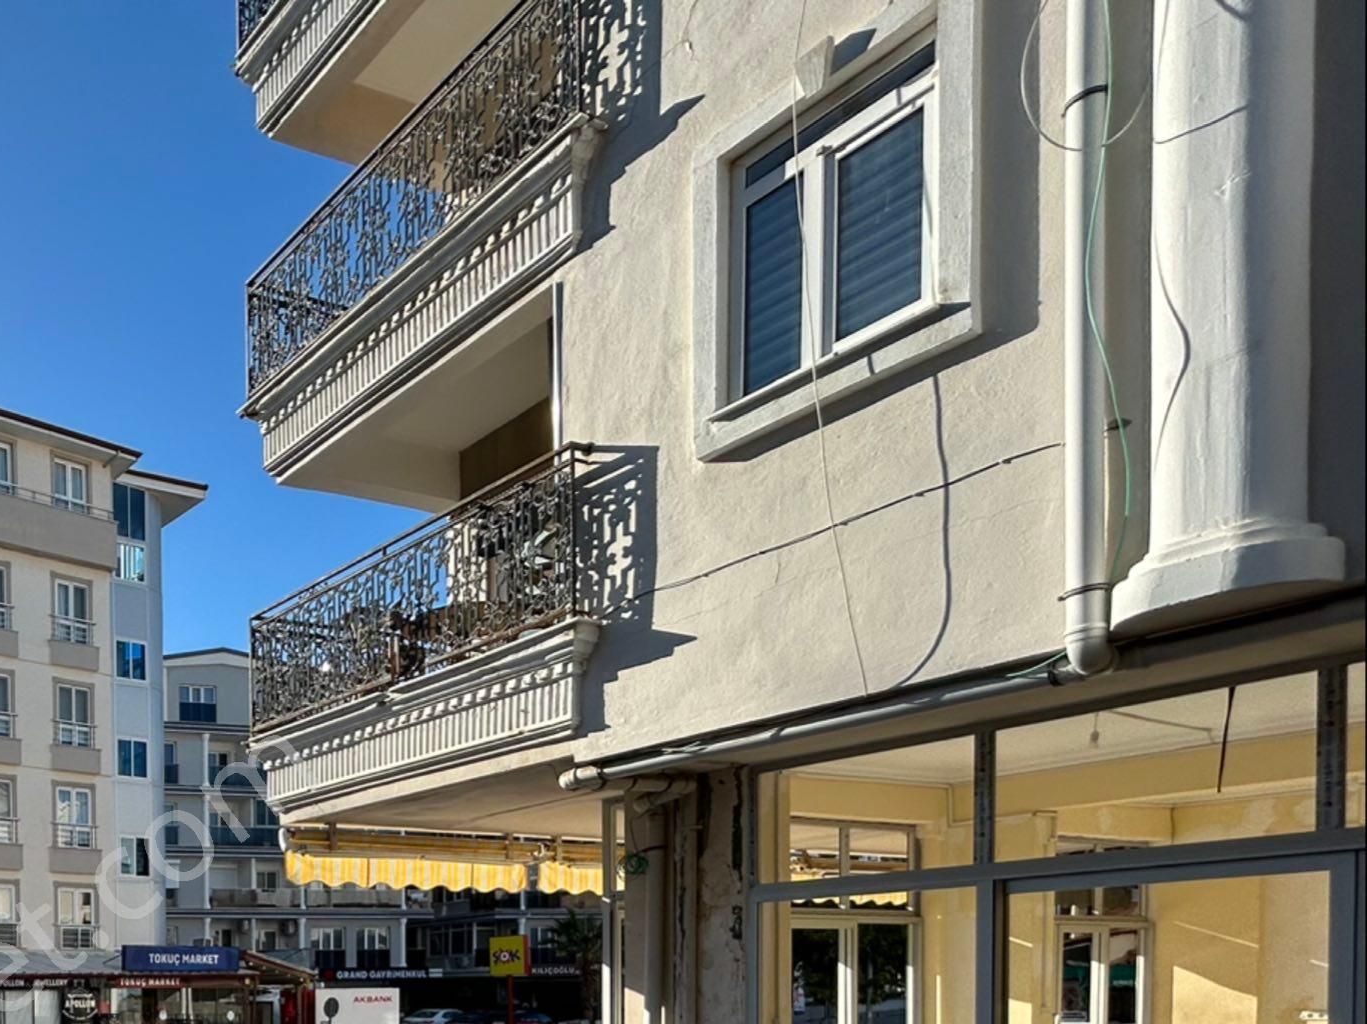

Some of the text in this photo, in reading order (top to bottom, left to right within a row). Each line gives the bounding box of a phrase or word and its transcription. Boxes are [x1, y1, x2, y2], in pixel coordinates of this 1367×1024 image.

[148, 953, 219, 966] TOKUÇ MARKET
[336, 970, 368, 979] GRAND
[120, 977, 181, 987] TOKUÇ MARKET
